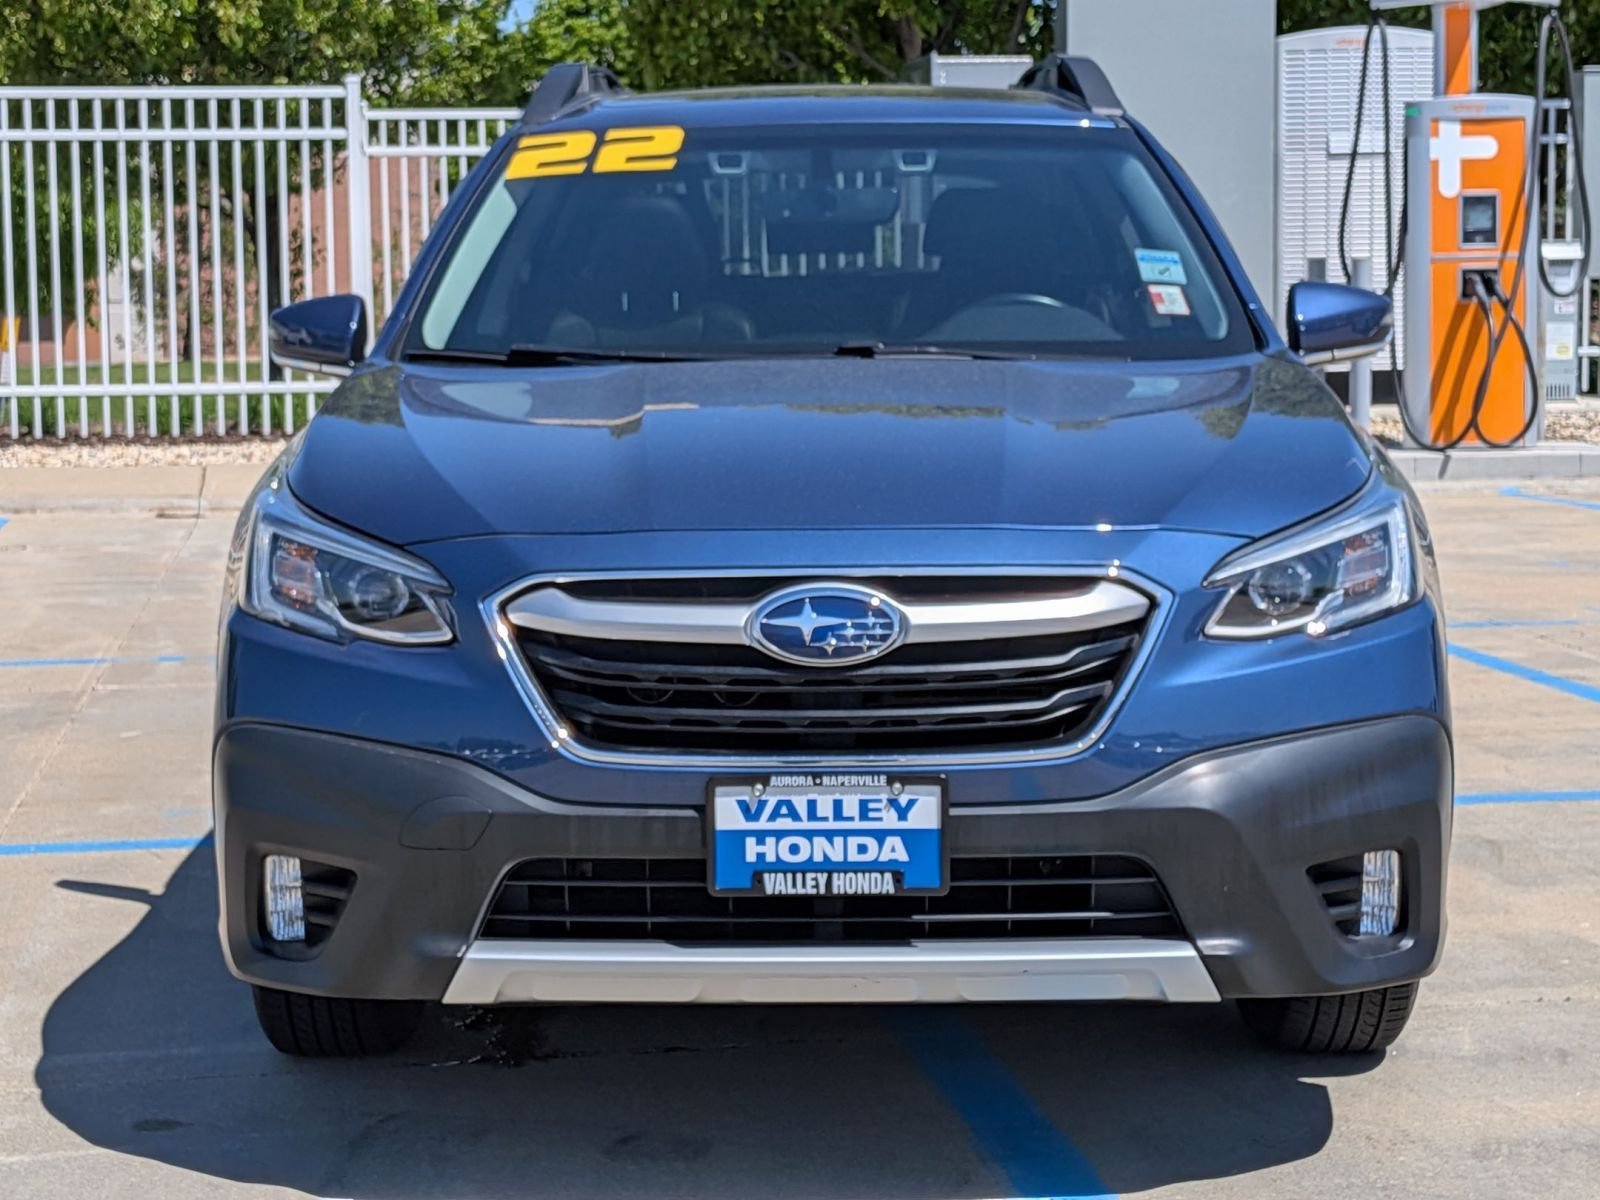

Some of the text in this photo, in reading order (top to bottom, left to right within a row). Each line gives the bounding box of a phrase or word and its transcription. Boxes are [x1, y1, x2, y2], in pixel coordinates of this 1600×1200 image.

[505, 125, 685, 180] 22
[770, 775, 887, 786] AURORA NAPERVILLE
[735, 798, 919, 823] VALLEY
[745, 836, 909, 863] HONDA
[763, 872, 895, 894] VALLEY HONDA
